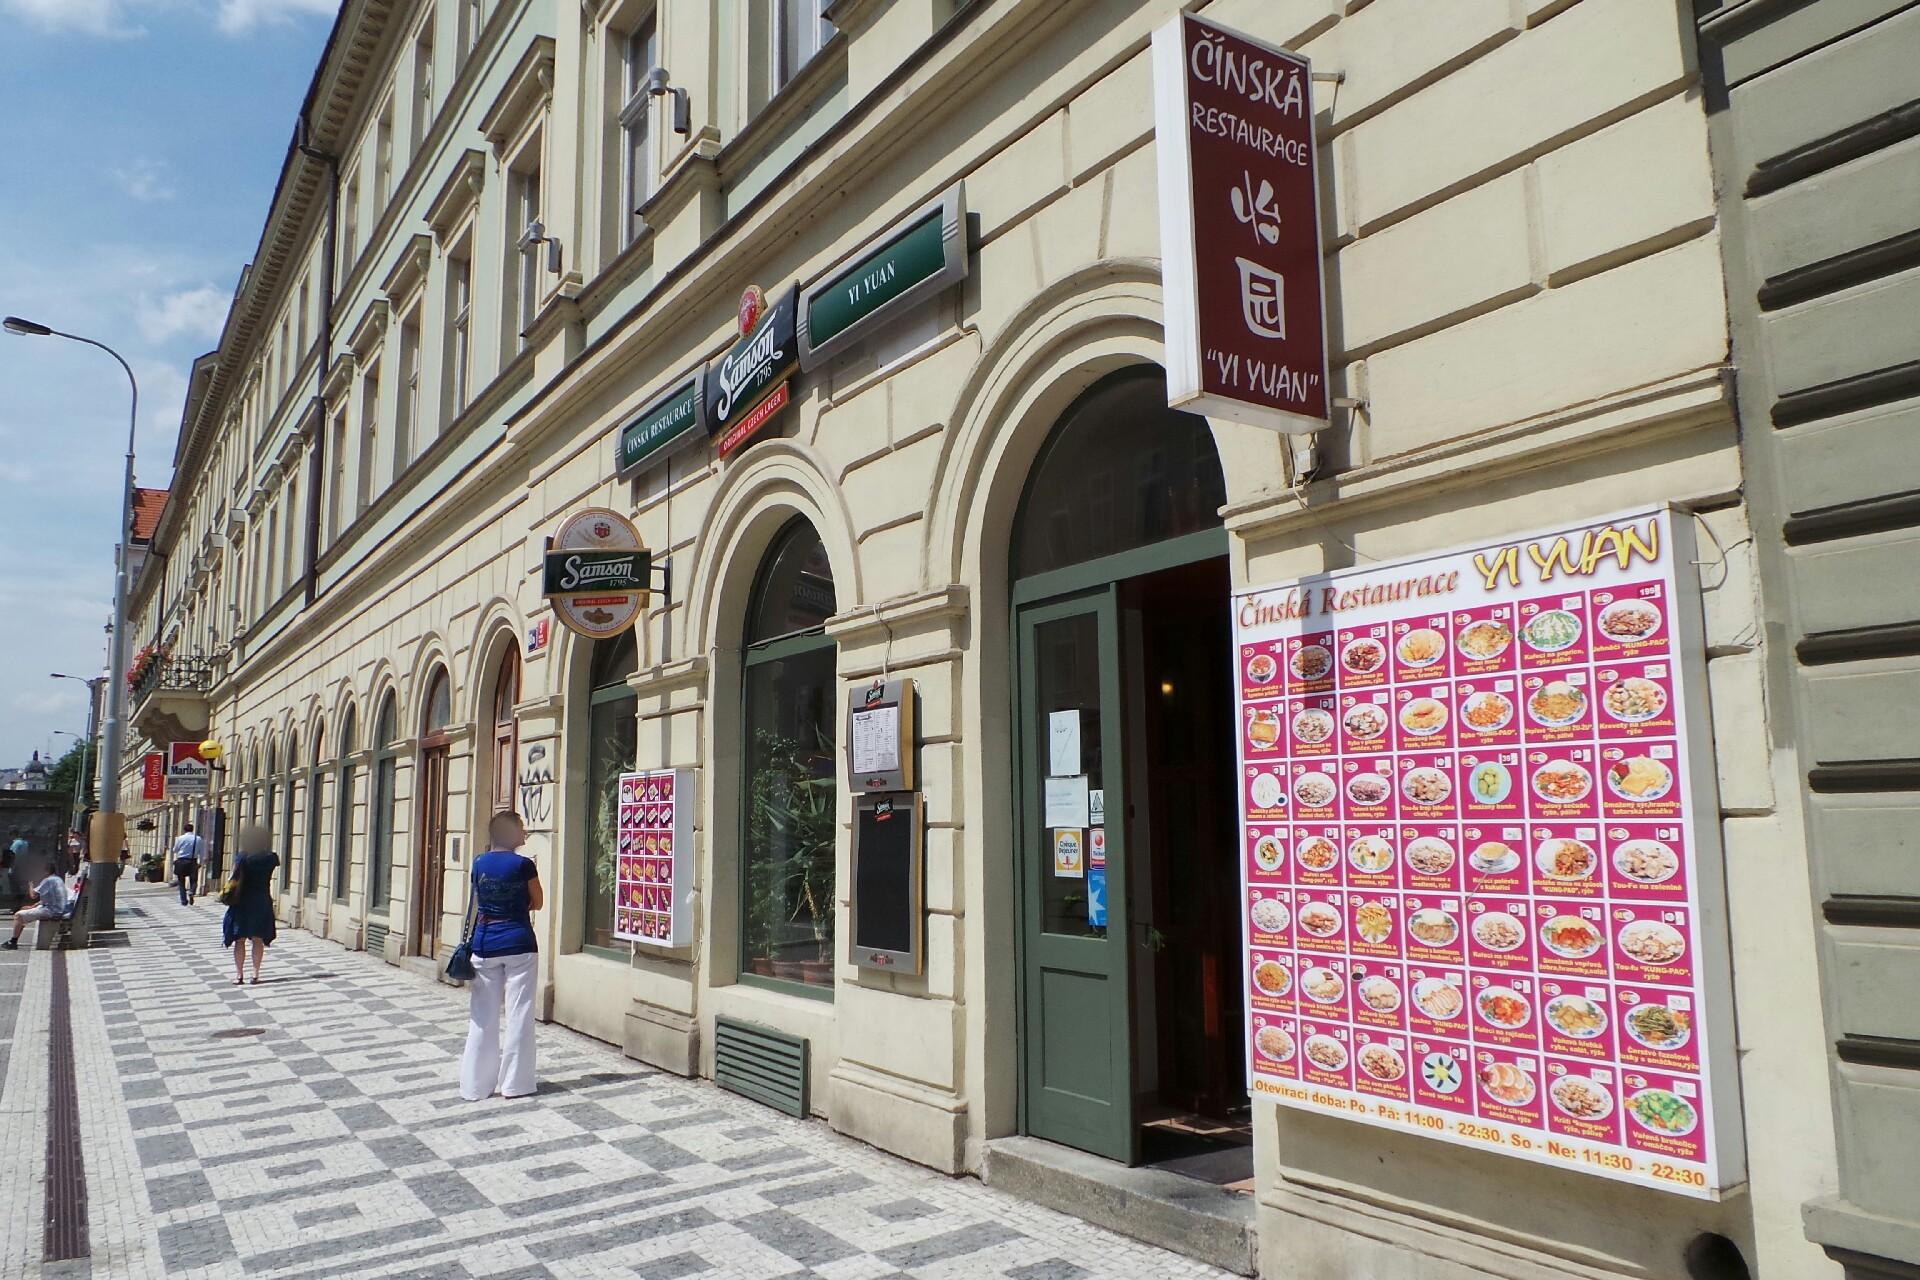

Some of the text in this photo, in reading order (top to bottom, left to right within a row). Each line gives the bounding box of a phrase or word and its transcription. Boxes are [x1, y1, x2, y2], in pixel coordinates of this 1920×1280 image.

[1192, 29, 1303, 119] ČÍNSKÁ
[1192, 101, 1308, 166] RESTAURACE
[848, 260, 895, 305] YI YUAN
[717, 326, 784, 421] Samson
[756, 363, 772, 388] 1795
[650, 398, 693, 439] RESTAURACE
[723, 393, 781, 451] ORIGINAL CZECH LAGER
[560, 555, 640, 590] Samson
[609, 578, 628, 587] 1795
[1238, 518, 1660, 630] Čínská Restaurace YI YUAN
[170, 763, 207, 775] Marlboro
[1312, 1091, 1346, 1109] doba:
[1350, 1100, 1366, 1113] Po
[1378, 1105, 1401, 1121] Pá:
[1404, 1111, 1444, 1130] 11:00
[1510, 1133, 1533, 1149] So
[1547, 1140, 1576, 1159] Ne:
[1582, 1148, 1633, 1171] 11:30
[1651, 1162, 1706, 1187] 22:30
